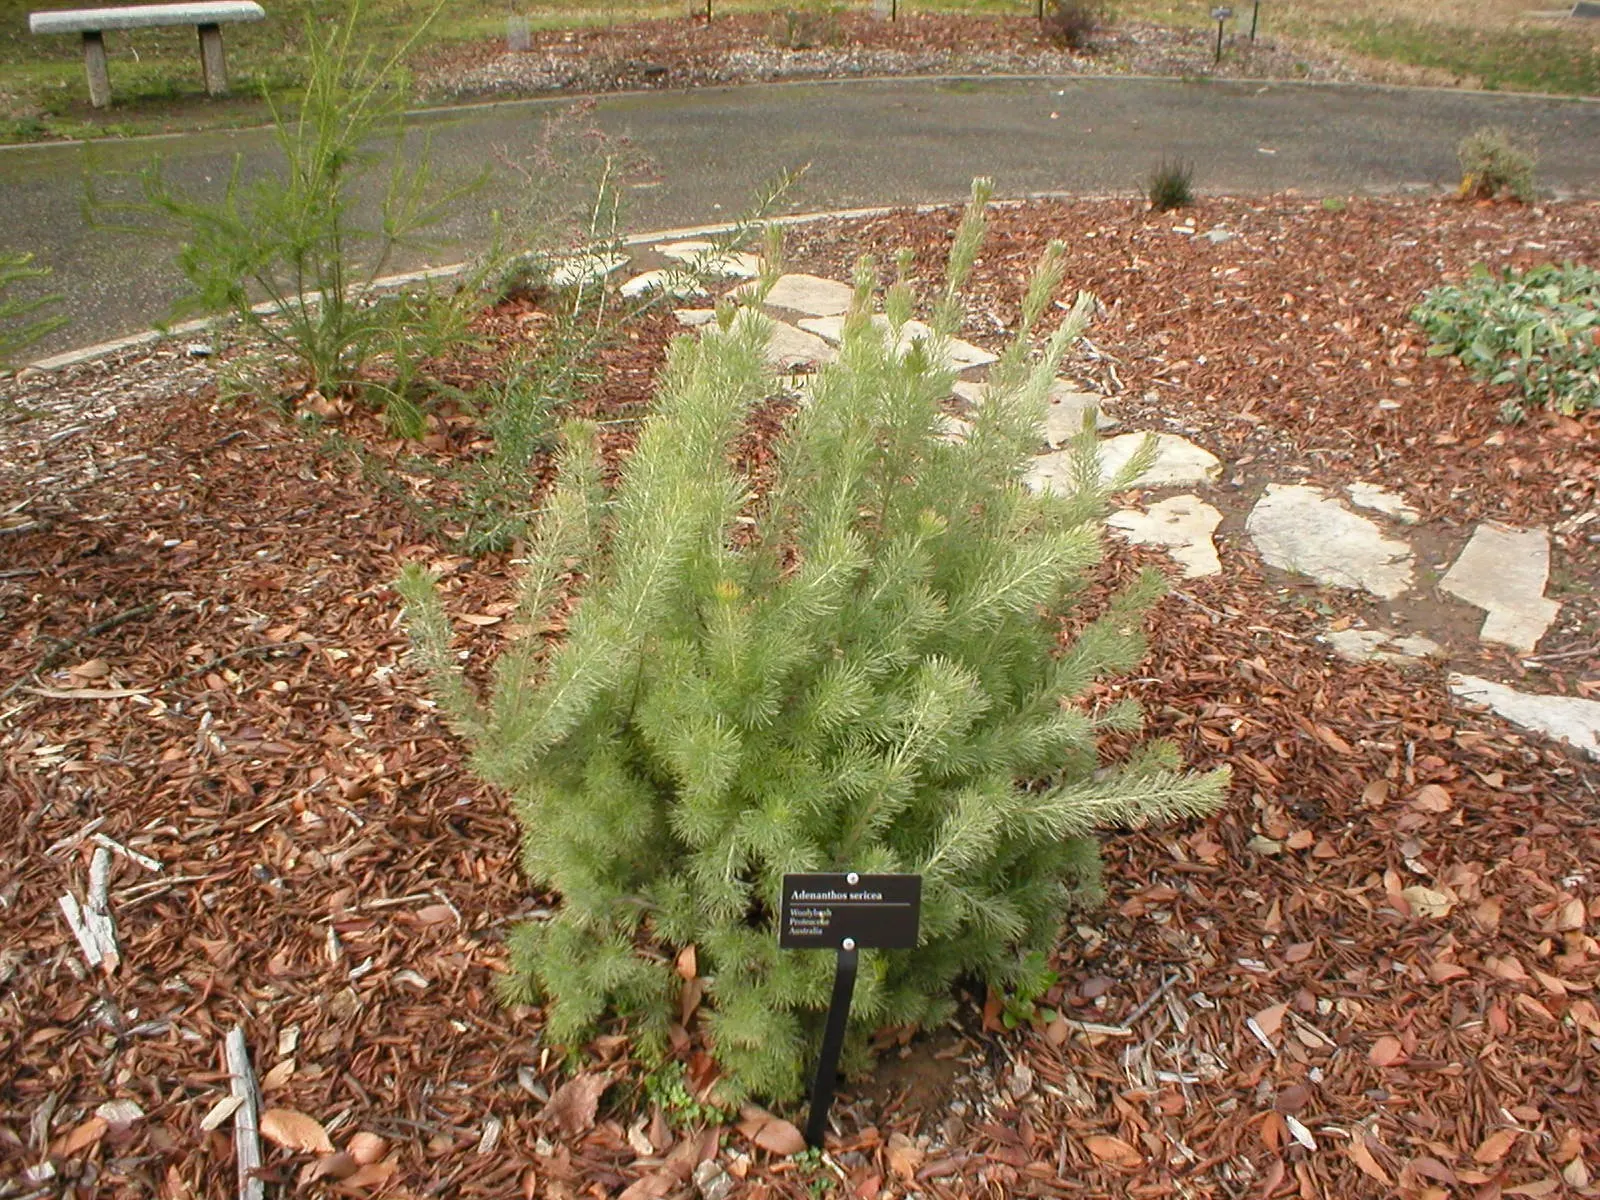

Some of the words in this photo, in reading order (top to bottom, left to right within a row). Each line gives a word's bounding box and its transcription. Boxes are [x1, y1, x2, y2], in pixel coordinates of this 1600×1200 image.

[791, 890, 847, 900] Adenanthos
[849, 890, 882, 900] sericea
[788, 926, 823, 935] Australia
